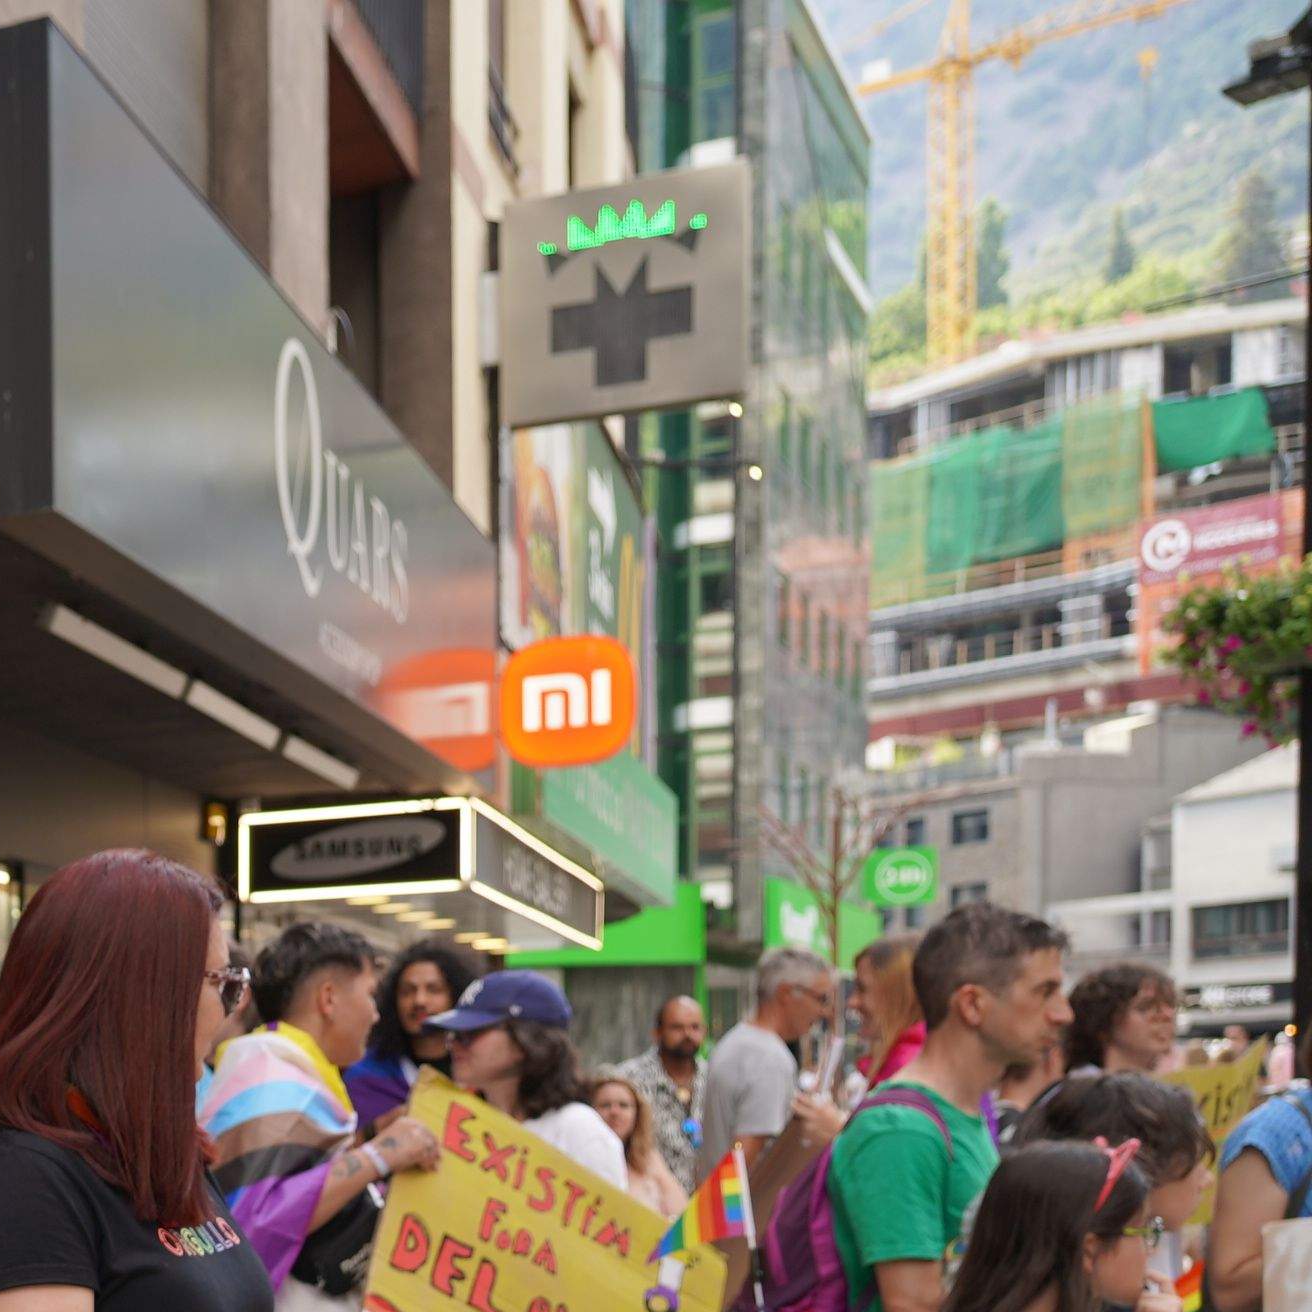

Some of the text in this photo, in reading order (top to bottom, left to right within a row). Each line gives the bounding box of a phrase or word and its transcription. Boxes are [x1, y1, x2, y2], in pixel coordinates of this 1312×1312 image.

[276, 338, 408, 624] QUARS
[294, 833, 423, 863] SAMSUNG
[157, 1216, 241, 1256] ORGULLO
